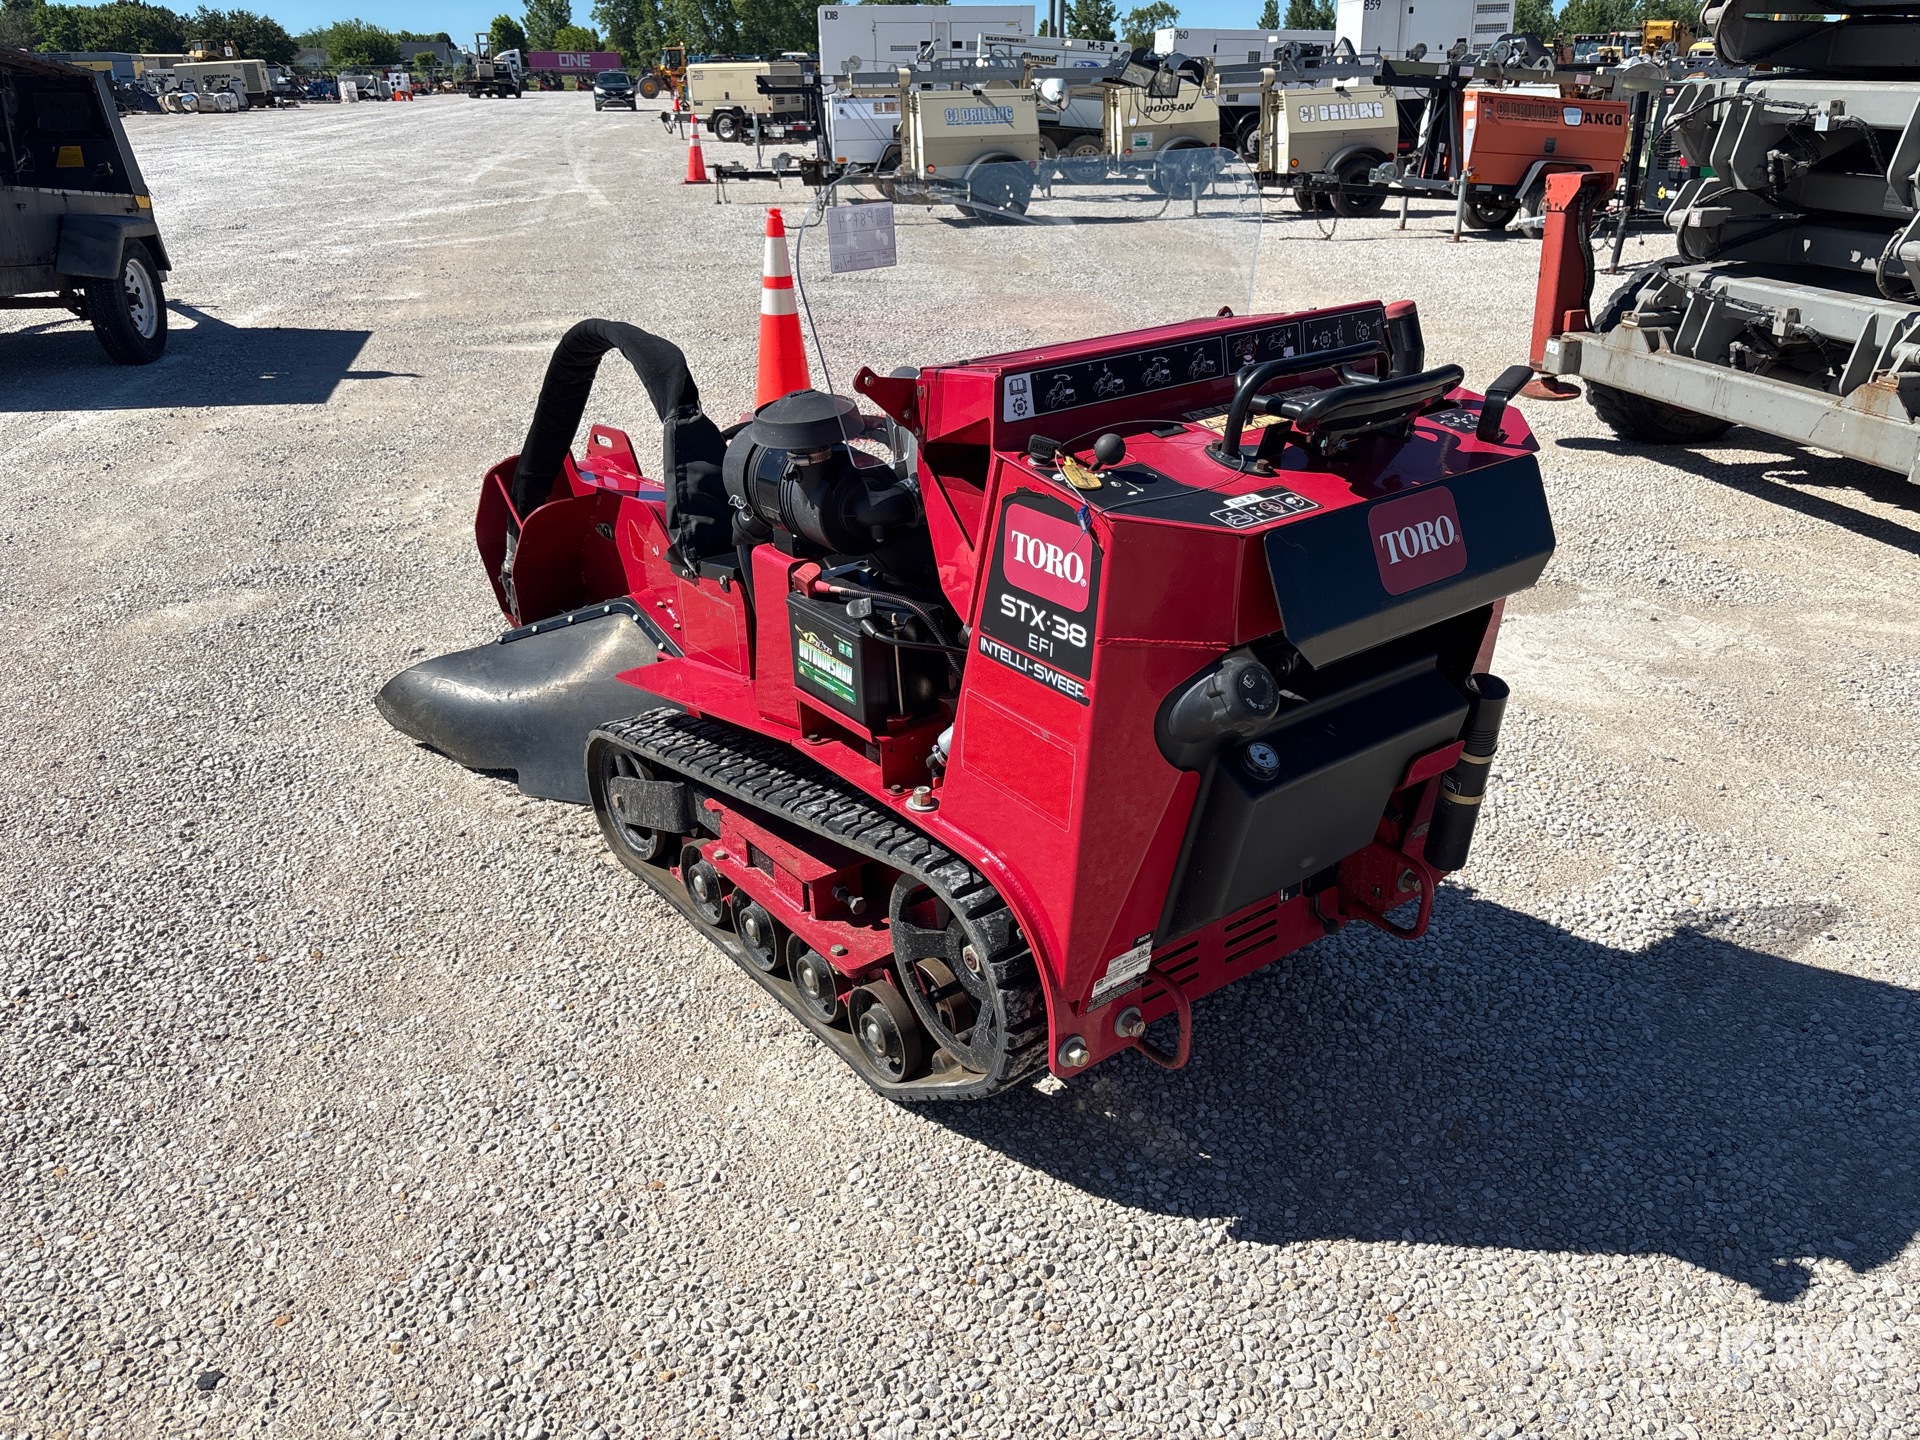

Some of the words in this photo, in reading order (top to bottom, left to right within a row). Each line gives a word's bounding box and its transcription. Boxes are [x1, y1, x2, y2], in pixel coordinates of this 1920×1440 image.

[824, 10, 839, 21] 1018
[1175, 30, 1189, 40] 760
[1087, 41, 1106, 51] M-5
[558, 53, 591, 67] ONE
[945, 107, 959, 123] CJ
[961, 105, 1014, 122] DRILLING
[1145, 103, 1194, 114] DOOSAN
[1299, 104, 1316, 123] CJ
[1318, 101, 1384, 121] DRILLING
[1510, 102, 1558, 119] DRILLING
[1379, 515, 1455, 565] TORO
[1011, 530, 1084, 584] TORO
[1028, 632, 1054, 658] EFI
